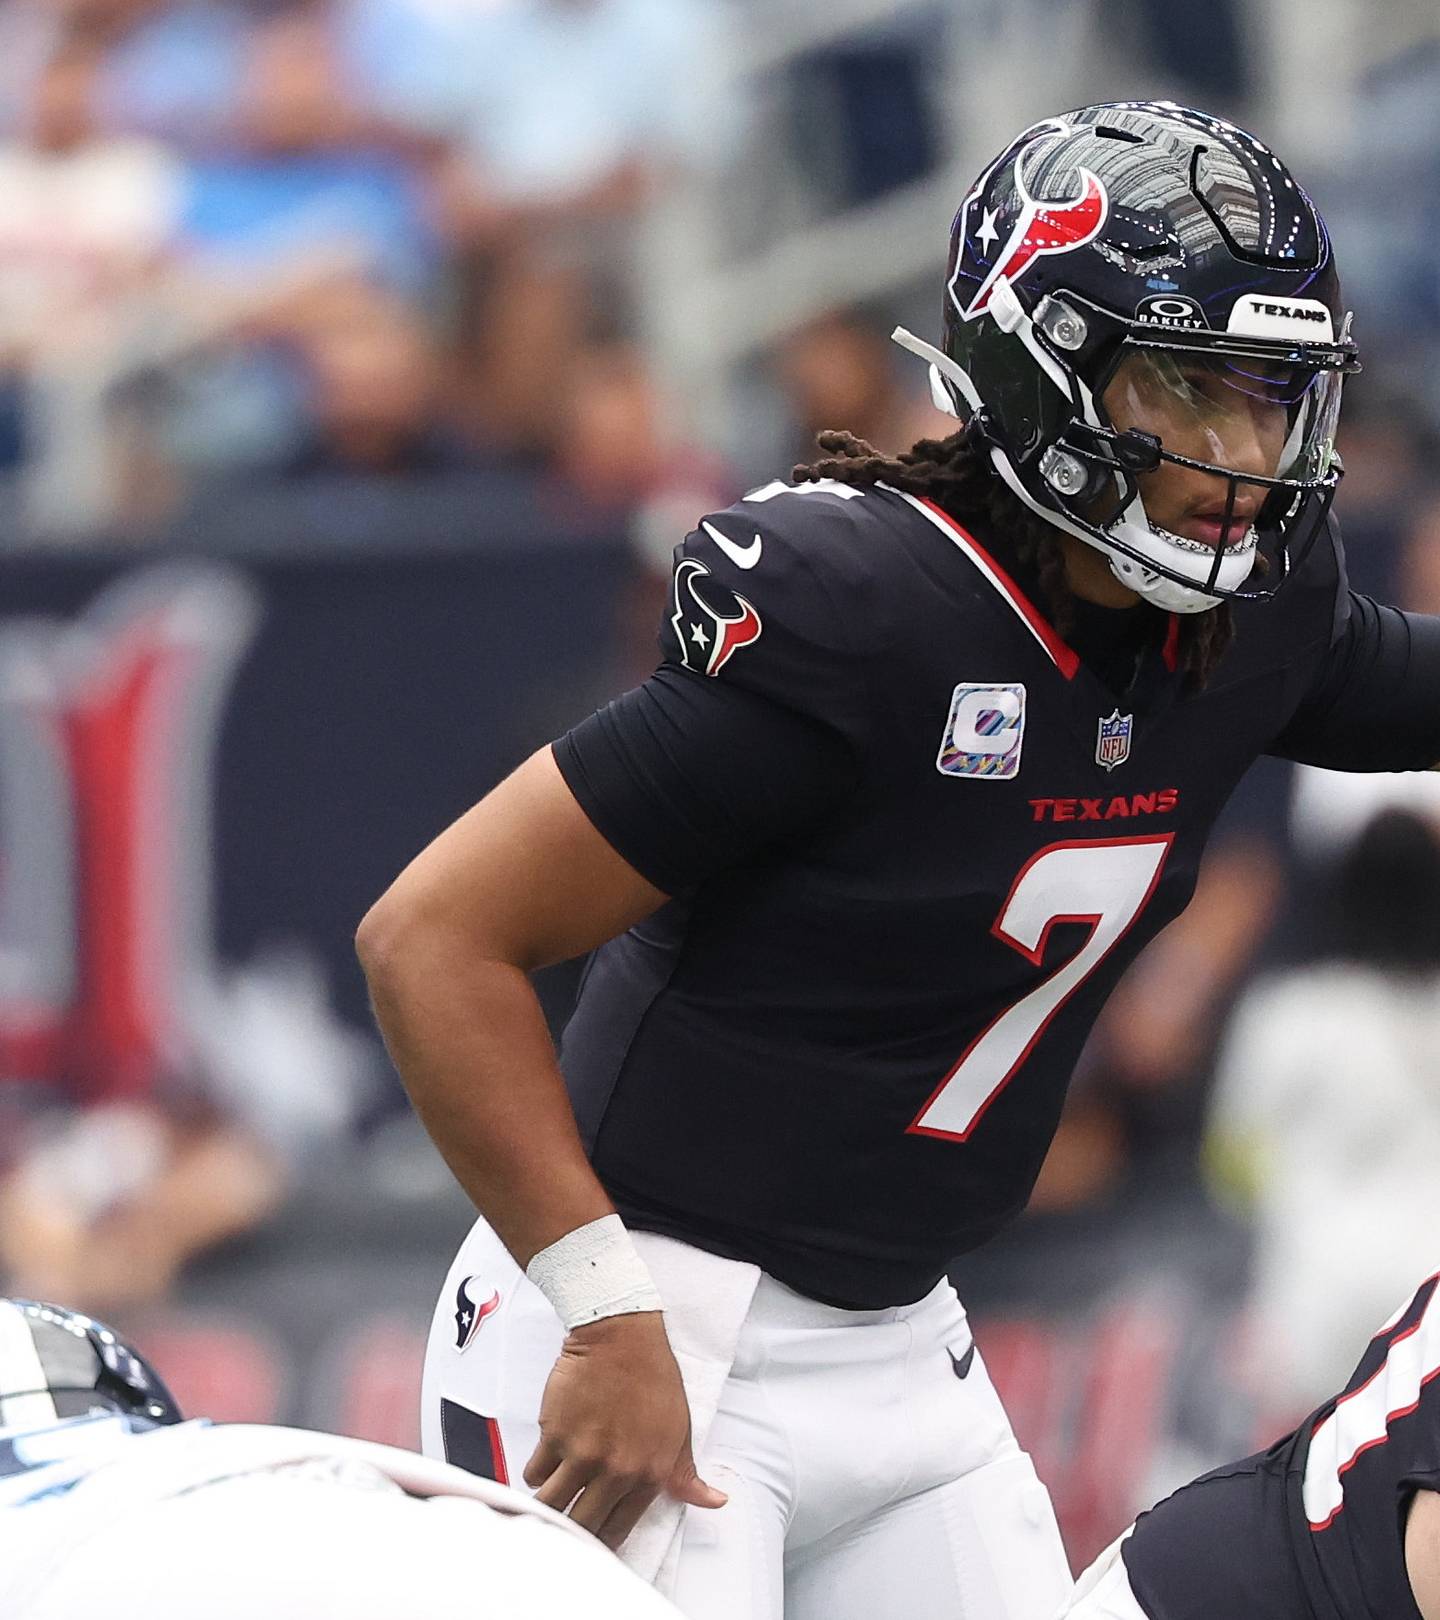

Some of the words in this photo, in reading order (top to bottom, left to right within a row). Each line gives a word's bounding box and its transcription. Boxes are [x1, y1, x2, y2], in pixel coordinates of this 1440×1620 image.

[1139, 314, 1203, 329] OAKLEY
[1250, 301, 1327, 323] TEXANS
[952, 690, 1021, 754] C
[1102, 737, 1127, 760] NFL
[1028, 789, 1179, 822] TEXANS
[905, 832, 1175, 1142] 7
